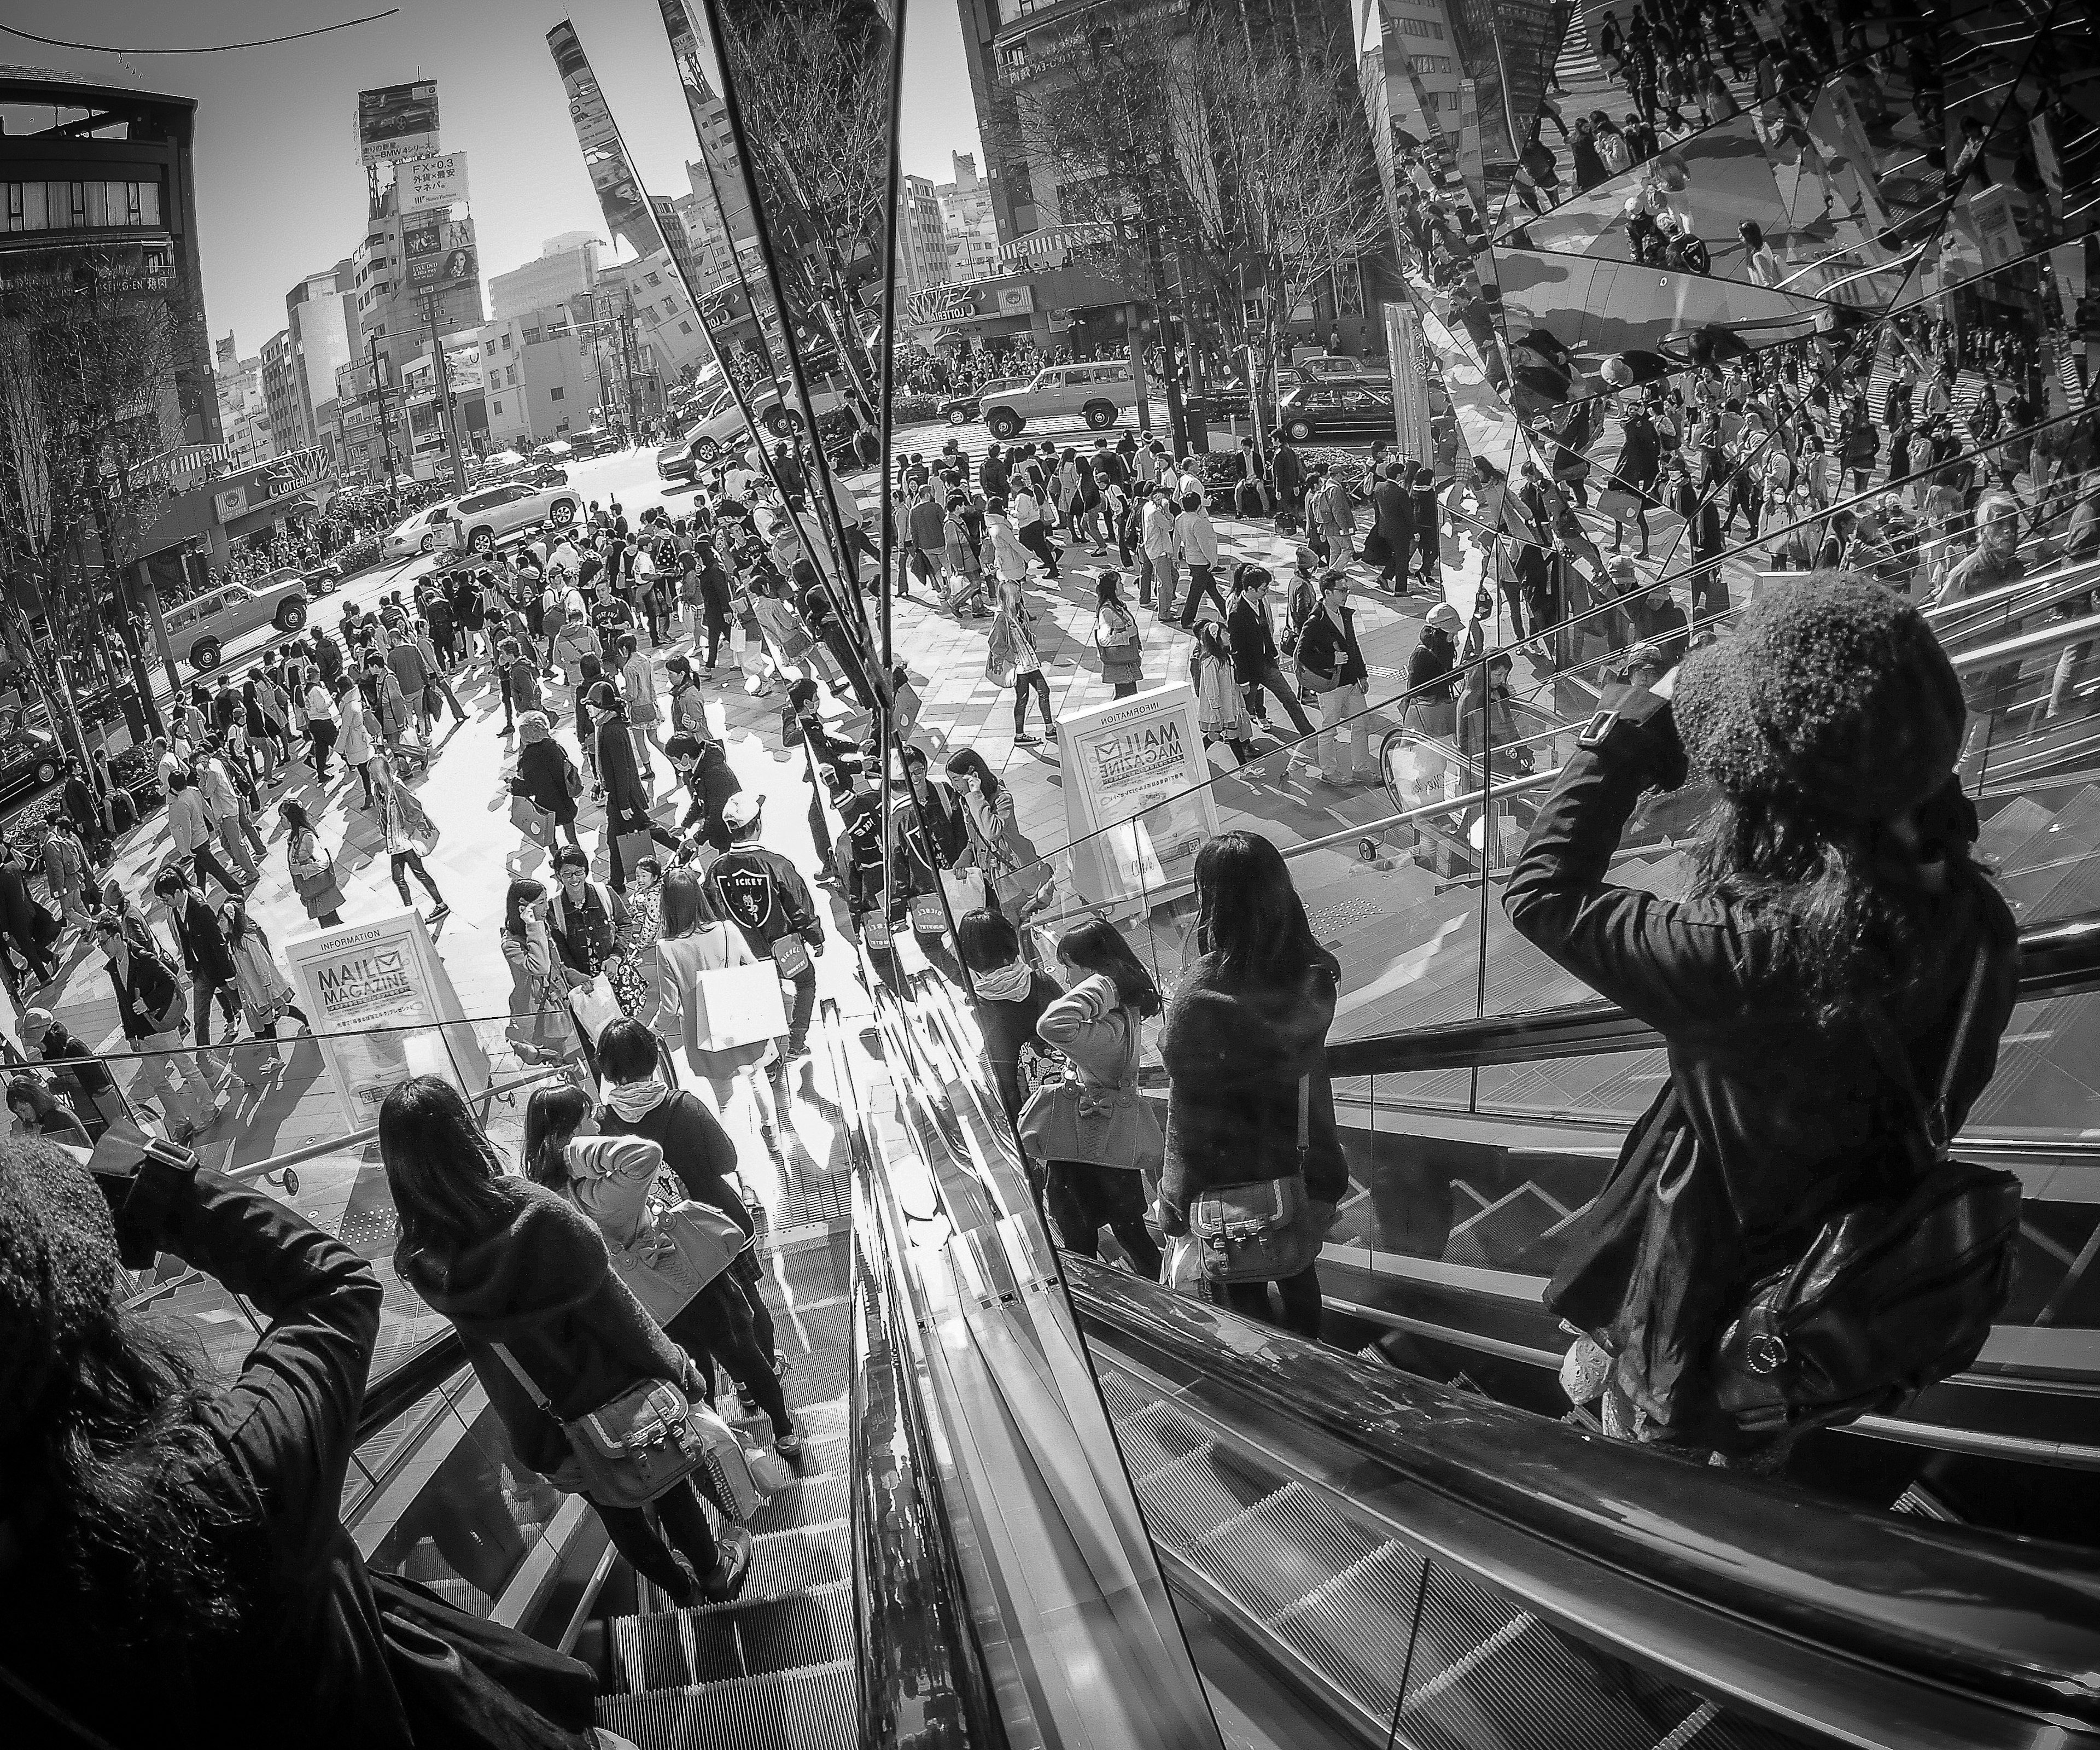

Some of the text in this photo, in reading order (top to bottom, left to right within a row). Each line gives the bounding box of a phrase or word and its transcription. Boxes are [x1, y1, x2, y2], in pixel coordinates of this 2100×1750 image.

[279, 475, 311, 494] LOTTERIA
[320, 930, 381, 951] INFORMATION
[317, 958, 376, 991] MAIL
[323, 971, 409, 1006] MAGAZINE
